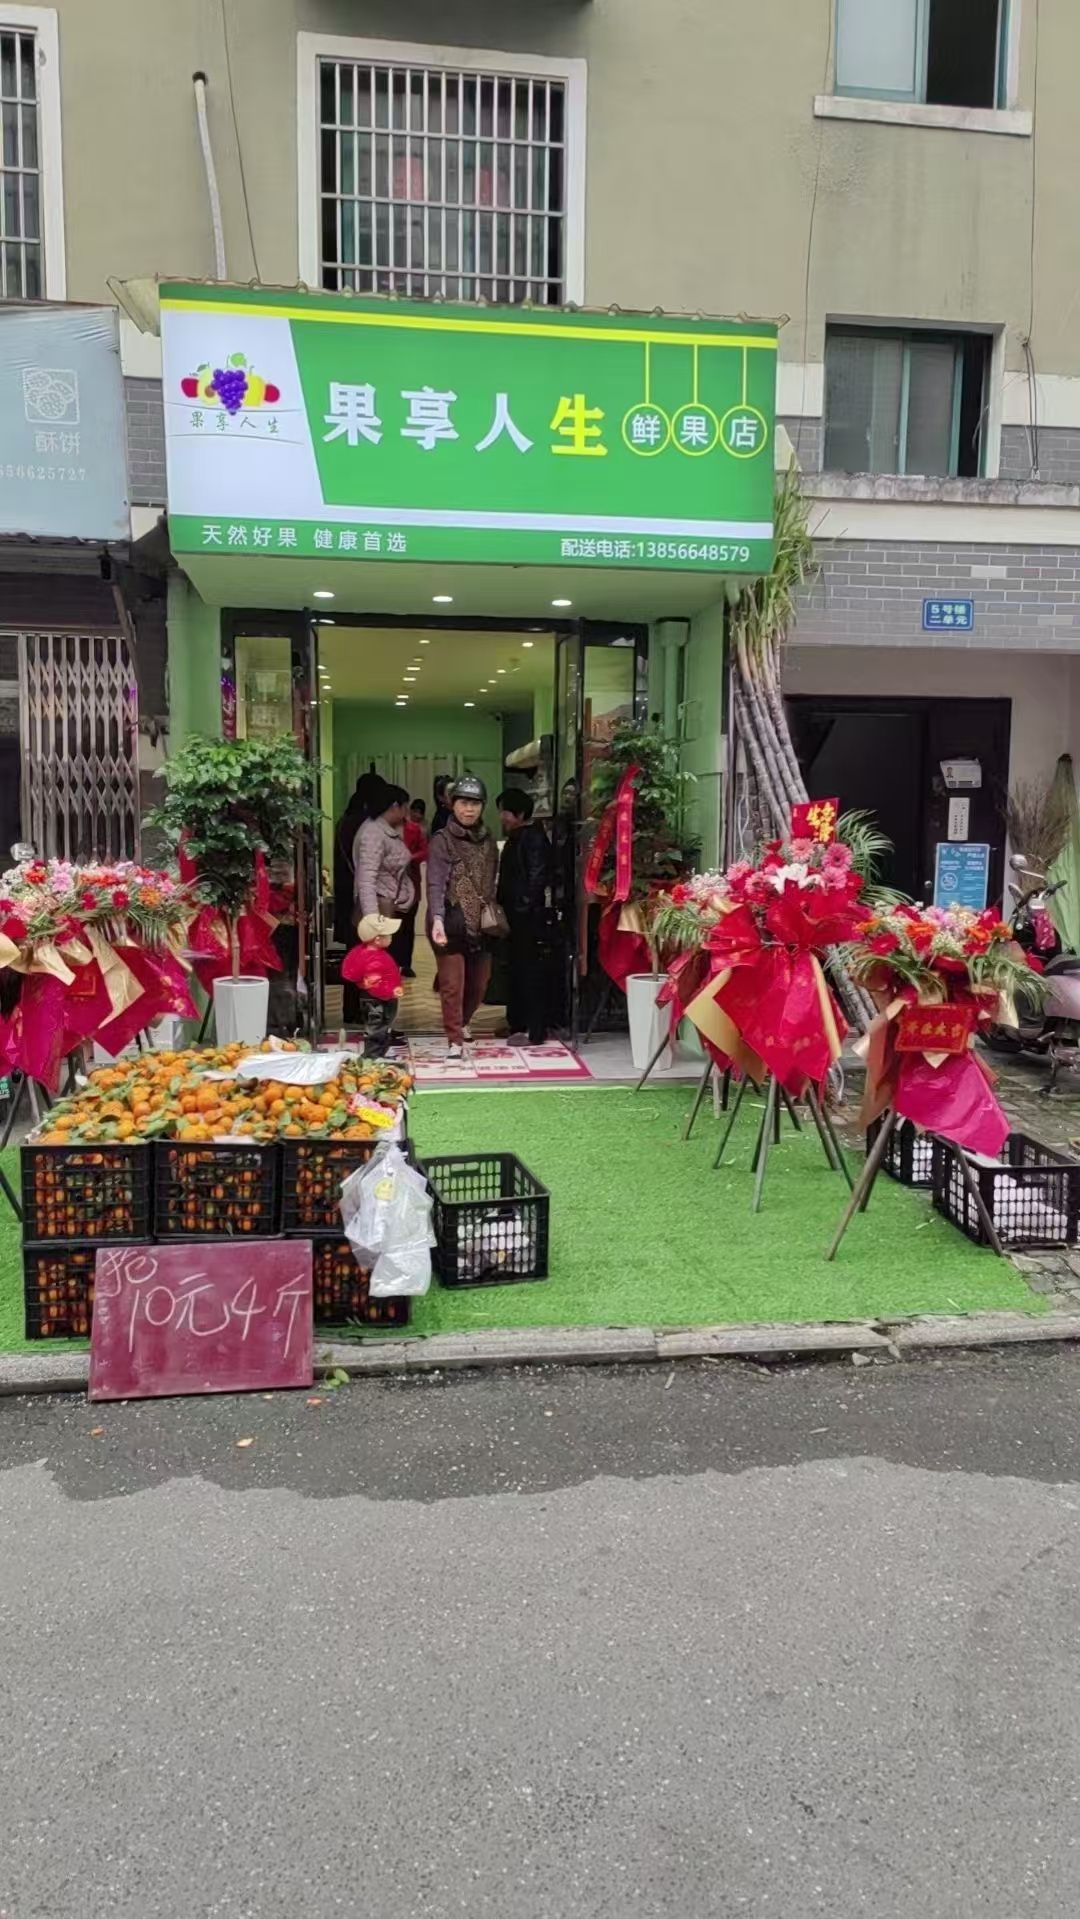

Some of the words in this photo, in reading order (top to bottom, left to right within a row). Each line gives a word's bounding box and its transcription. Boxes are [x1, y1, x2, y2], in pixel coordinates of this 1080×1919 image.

[190, 411, 279, 434] 果享人生
[322, 381, 609, 456] 果享人生
[631, 413, 758, 448] 鲜果店
[202, 524, 298, 548] 天然好果
[313, 528, 408, 553] 健康首选
[560, 538, 751, 563] 配送电话:13856648579
[128, 1272, 310, 1359] 10元4斤
